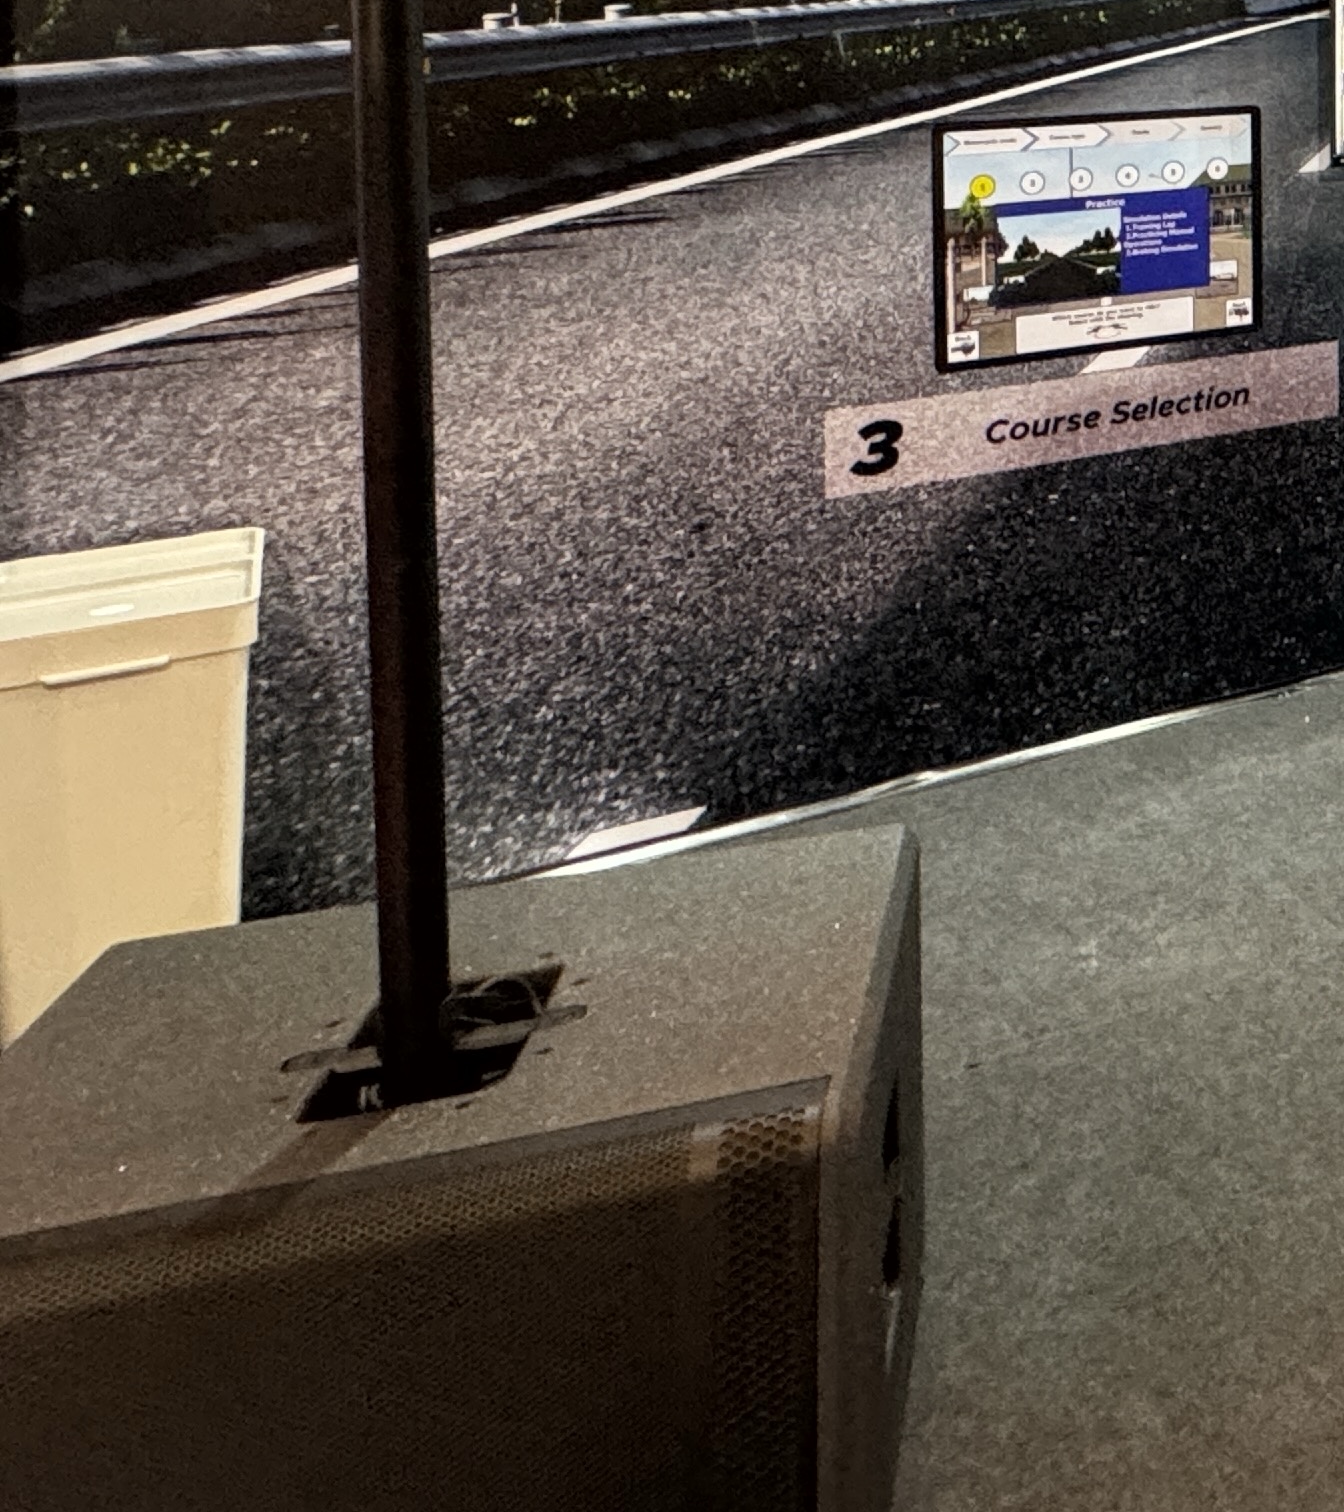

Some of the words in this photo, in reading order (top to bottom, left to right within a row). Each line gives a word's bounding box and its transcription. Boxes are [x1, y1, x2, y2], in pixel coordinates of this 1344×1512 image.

[848, 418, 904, 476] 3
[985, 408, 1102, 445] Course
[1110, 384, 1251, 425] Selection
